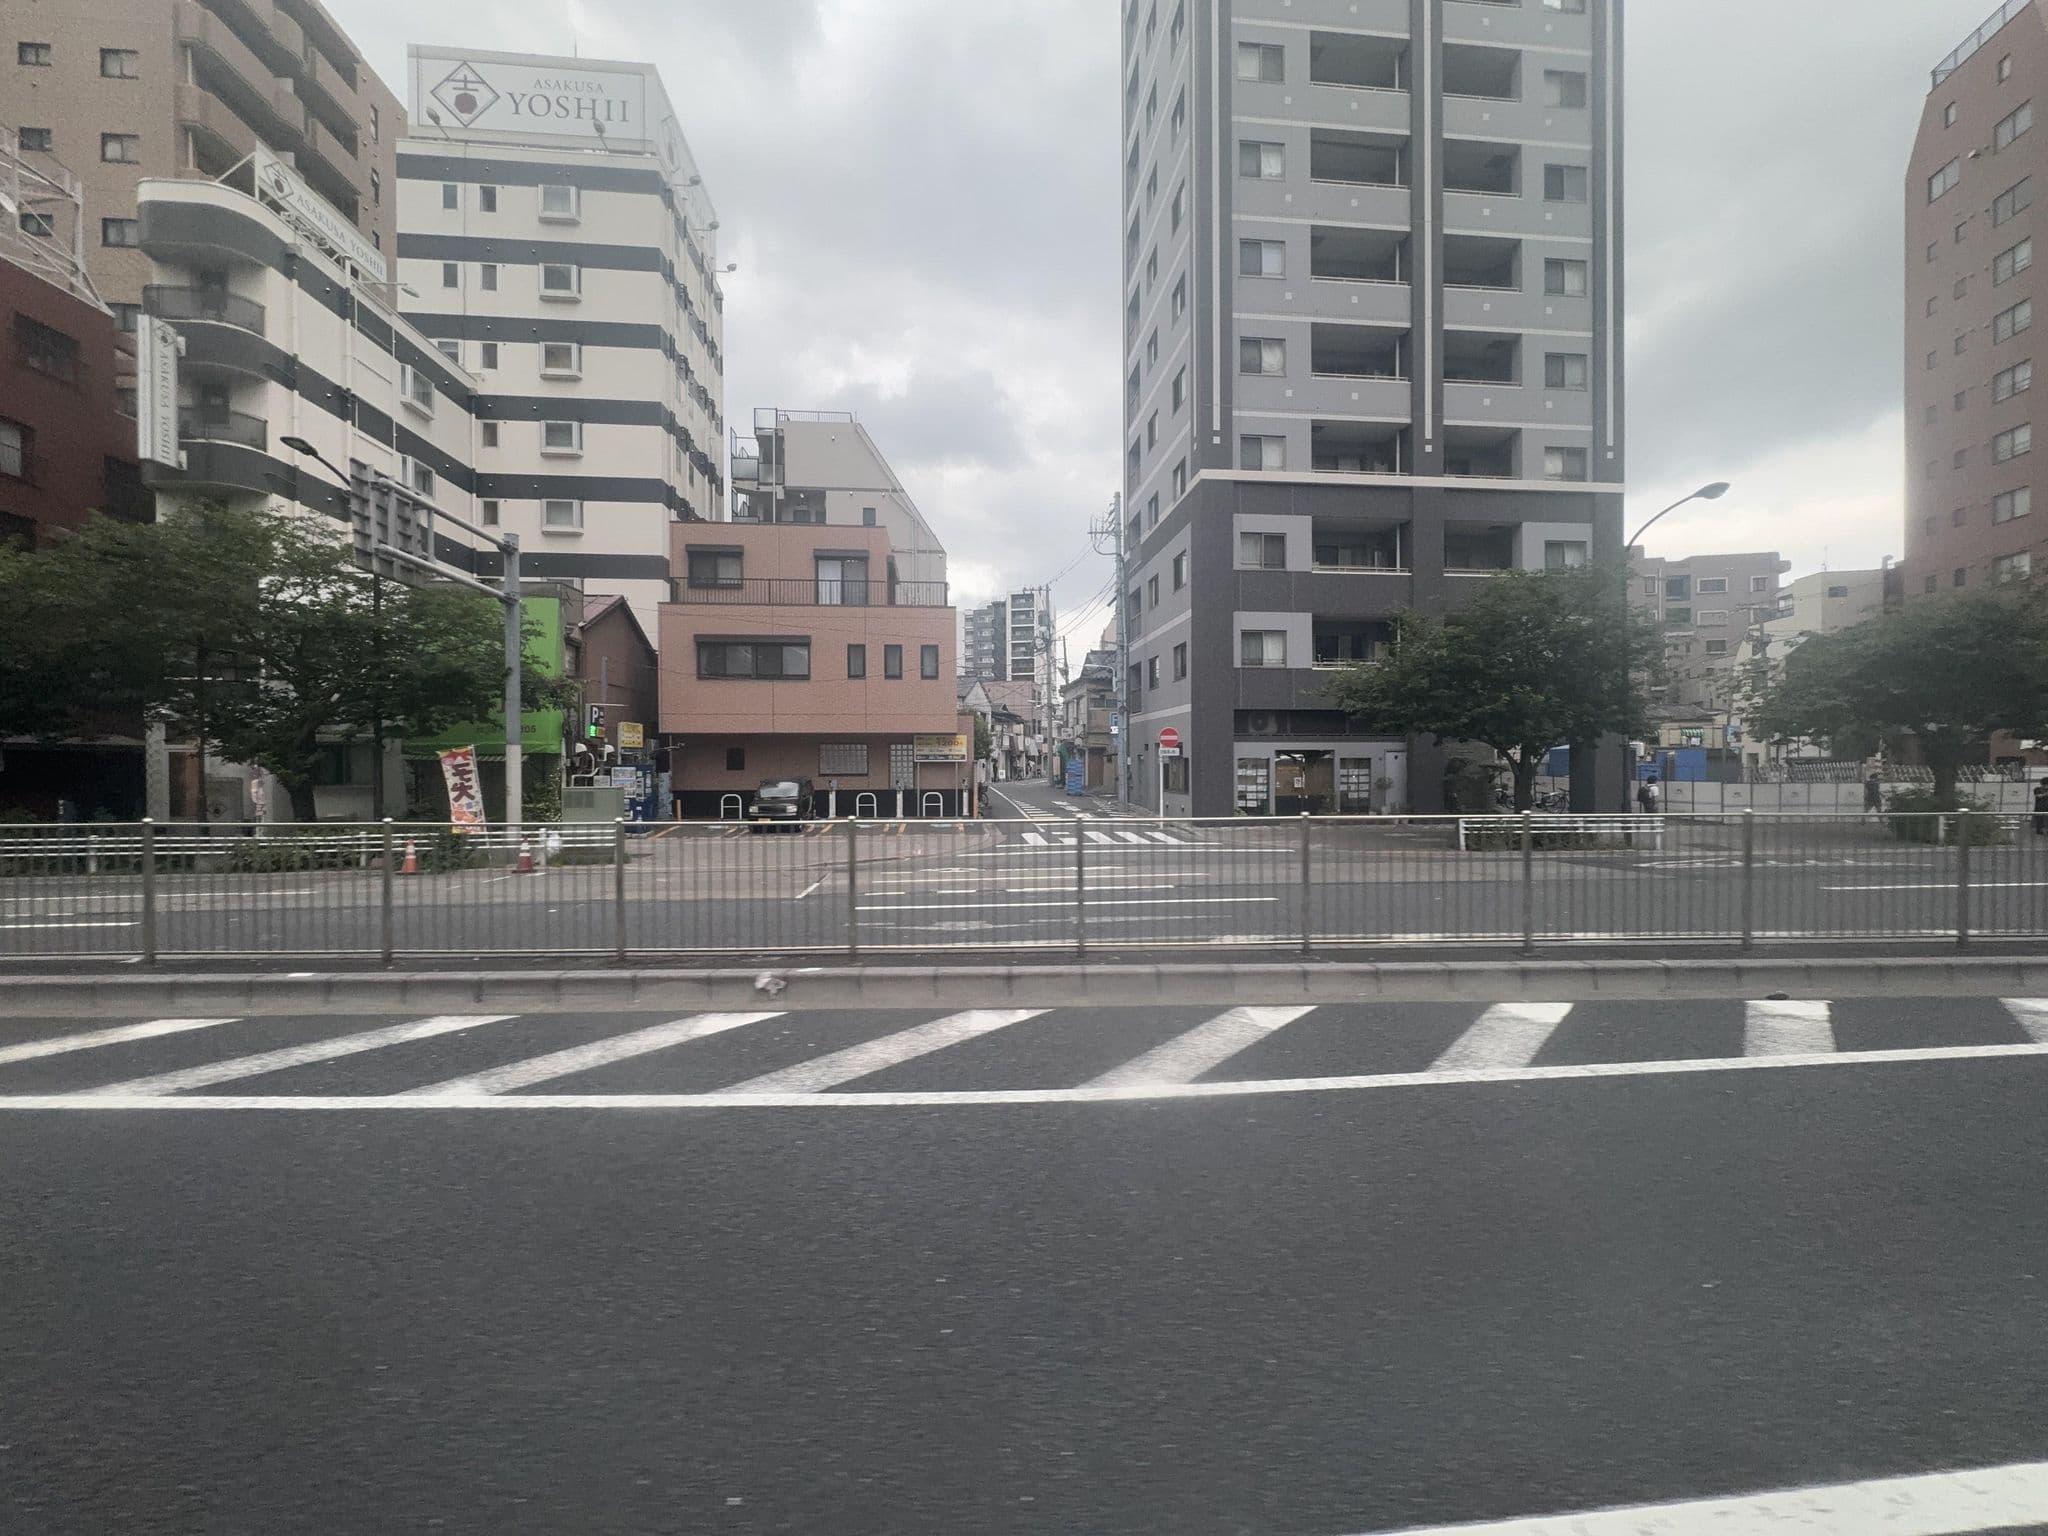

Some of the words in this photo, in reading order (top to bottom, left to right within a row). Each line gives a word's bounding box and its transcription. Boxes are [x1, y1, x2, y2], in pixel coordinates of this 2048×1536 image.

[534, 78, 604, 94] ASAKUSA
[506, 92, 630, 123] YOSHII
[297, 194, 346, 242] ASAKUSA
[350, 241, 384, 276] YOSHII
[160, 351, 169, 409] ASAKUSA
[160, 415, 170, 461] YOSHII
[592, 706, 599, 723] P
